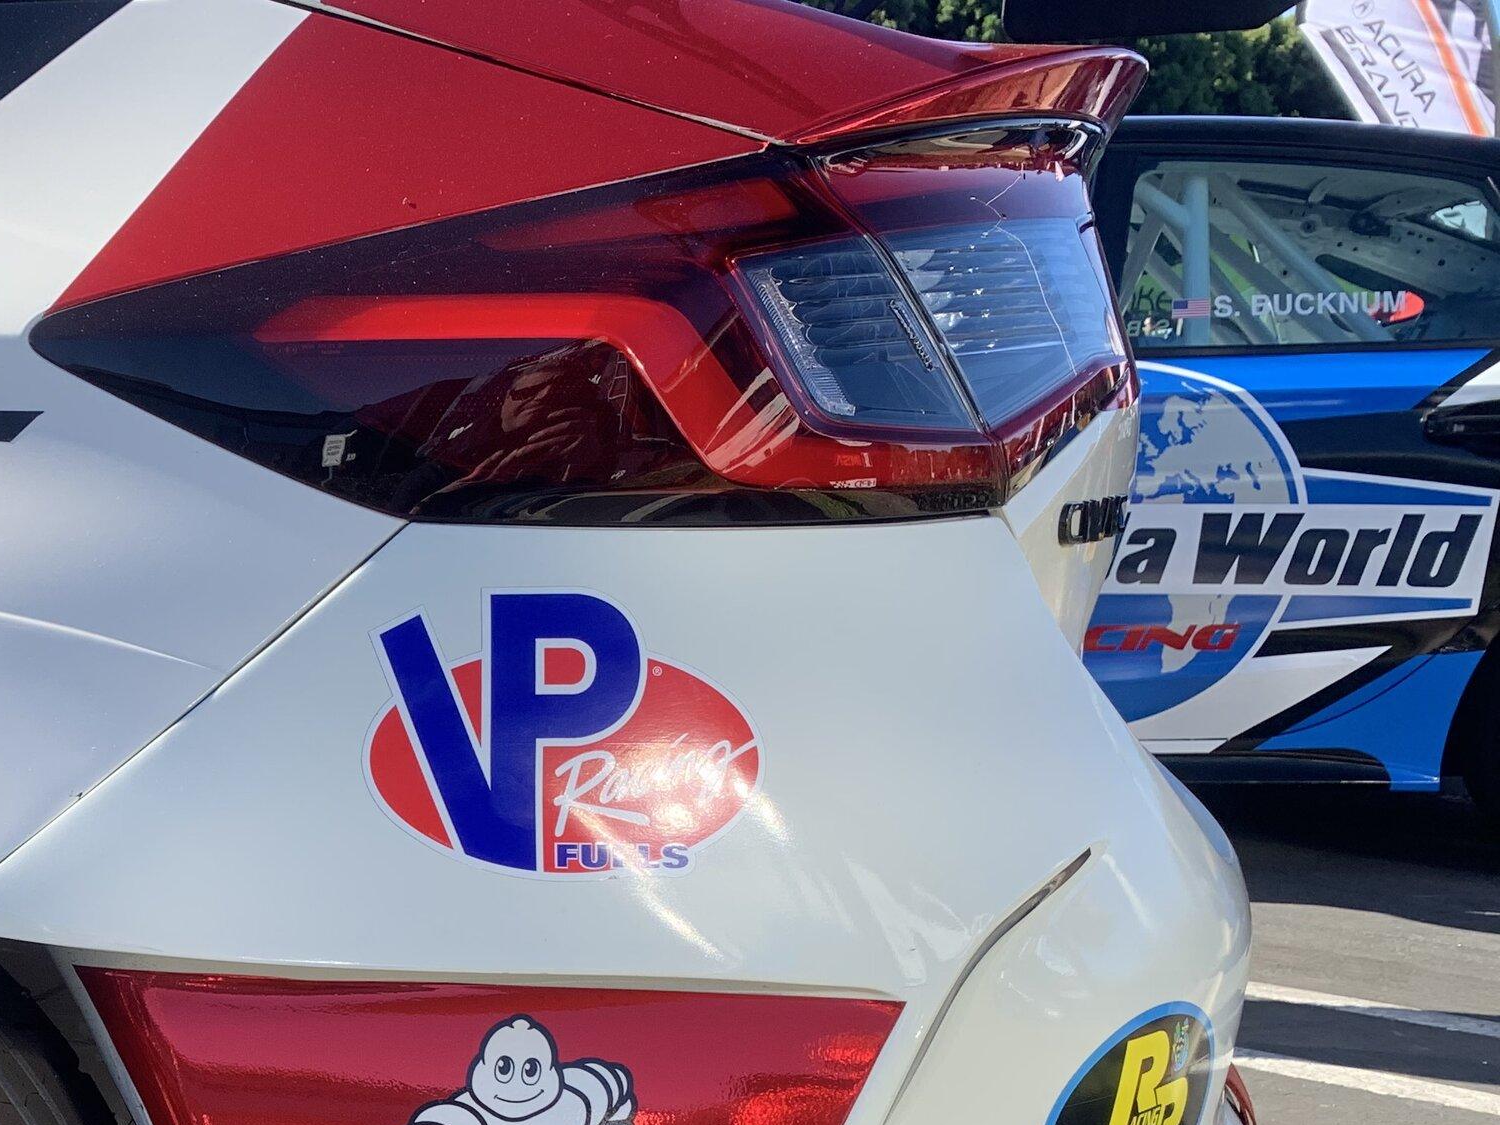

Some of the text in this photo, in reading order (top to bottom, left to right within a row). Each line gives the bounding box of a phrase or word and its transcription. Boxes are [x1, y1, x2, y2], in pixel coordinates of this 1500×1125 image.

[1363, 20, 1437, 113] ACURA
[1213, 290, 1408, 318] S. BUCKNUM
[1192, 512, 1484, 588] World
[379, 594, 641, 872] VP
